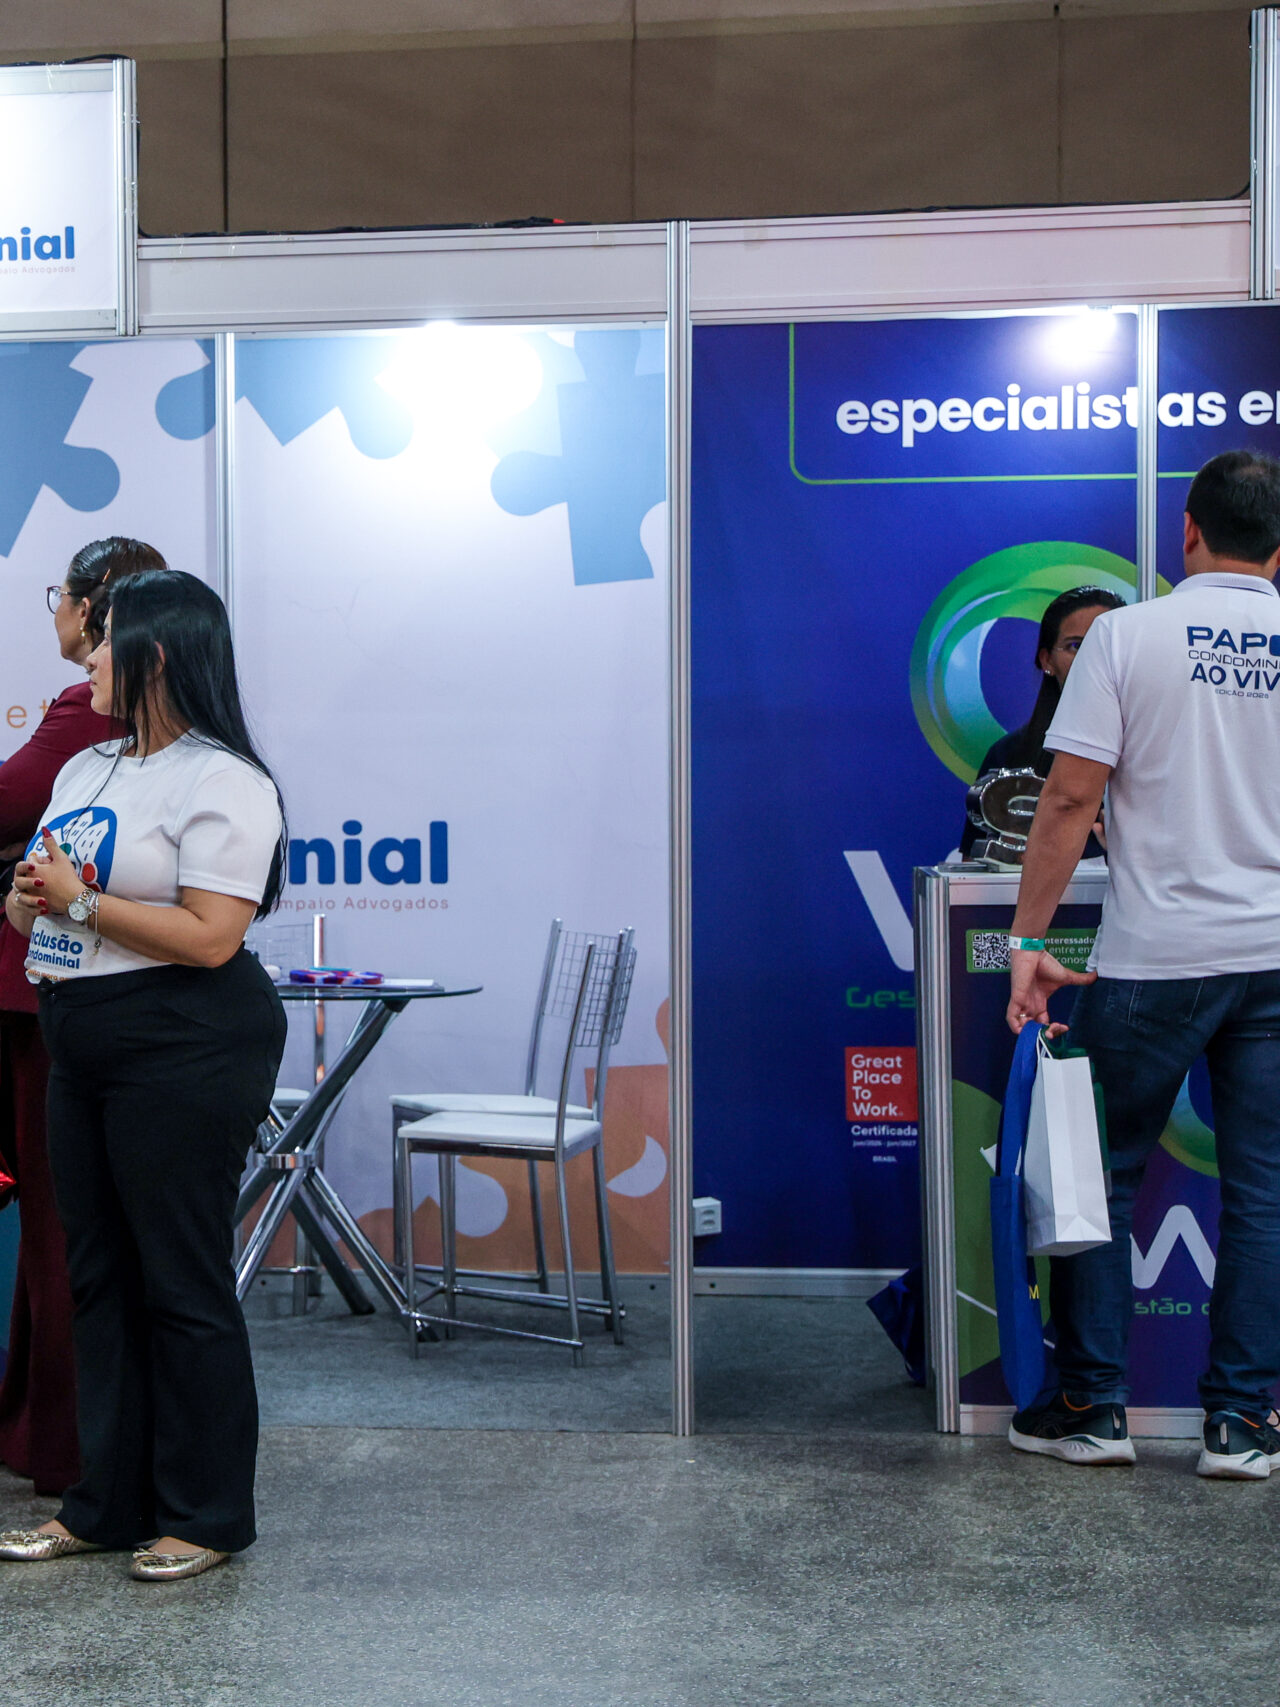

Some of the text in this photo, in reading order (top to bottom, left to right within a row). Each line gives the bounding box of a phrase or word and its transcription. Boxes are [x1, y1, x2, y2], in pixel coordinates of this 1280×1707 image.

[22, 265, 76, 275] Advogados
[835, 381, 1280, 448] especialistas e
[1190, 662, 1227, 685] AO
[343, 897, 449, 911] Advogados
[1049, 946, 1076, 954] entre
[846, 987, 917, 1008] Ges
[851, 1054, 903, 1069] Great
[852, 1070, 902, 1085] Place
[852, 1086, 872, 1101] To
[851, 1124, 918, 1137] Certificada
